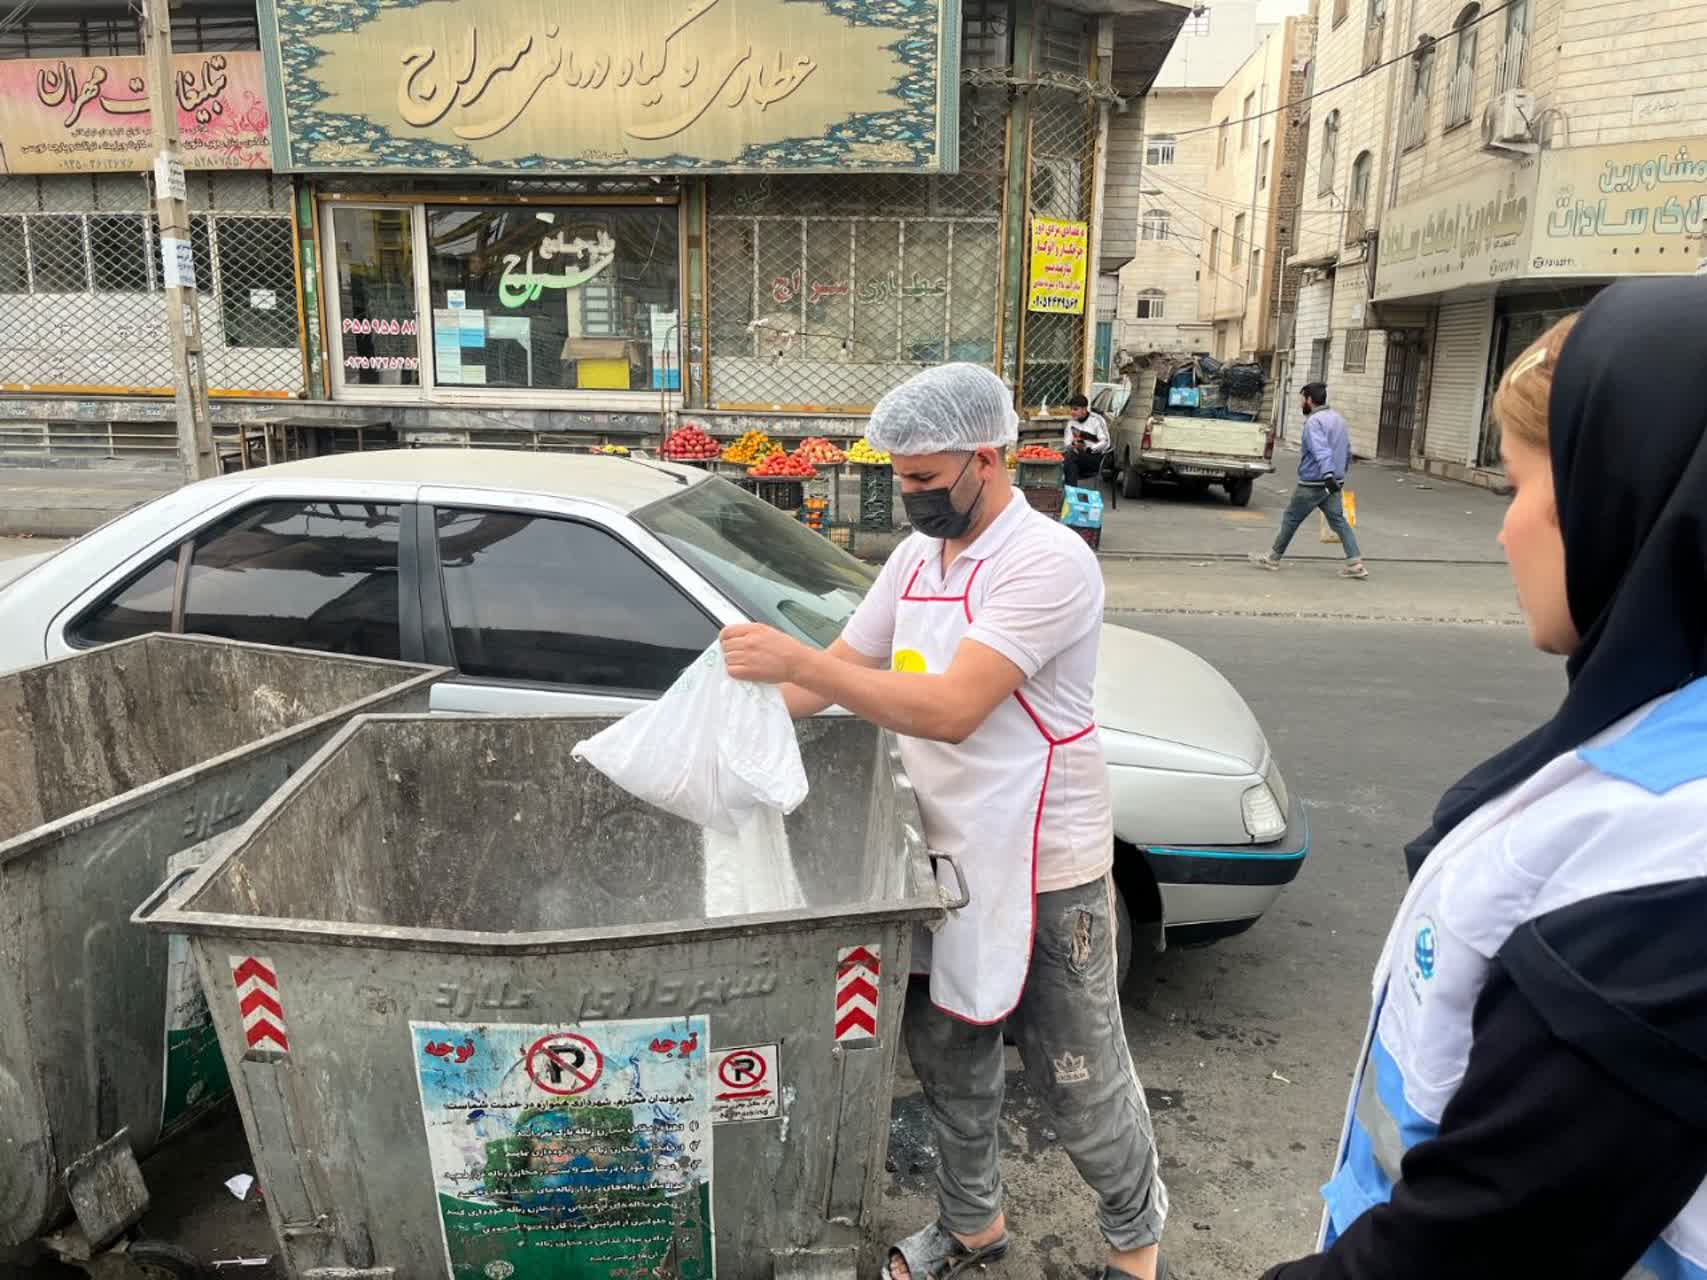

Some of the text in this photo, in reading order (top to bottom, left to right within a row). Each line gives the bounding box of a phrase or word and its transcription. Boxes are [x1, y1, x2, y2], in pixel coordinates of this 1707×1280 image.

[37, 60, 108, 128] مهران
[399, 26, 534, 129] سراج
[424, 1038, 476, 1063] توجه
[649, 1031, 699, 1058] توجه
